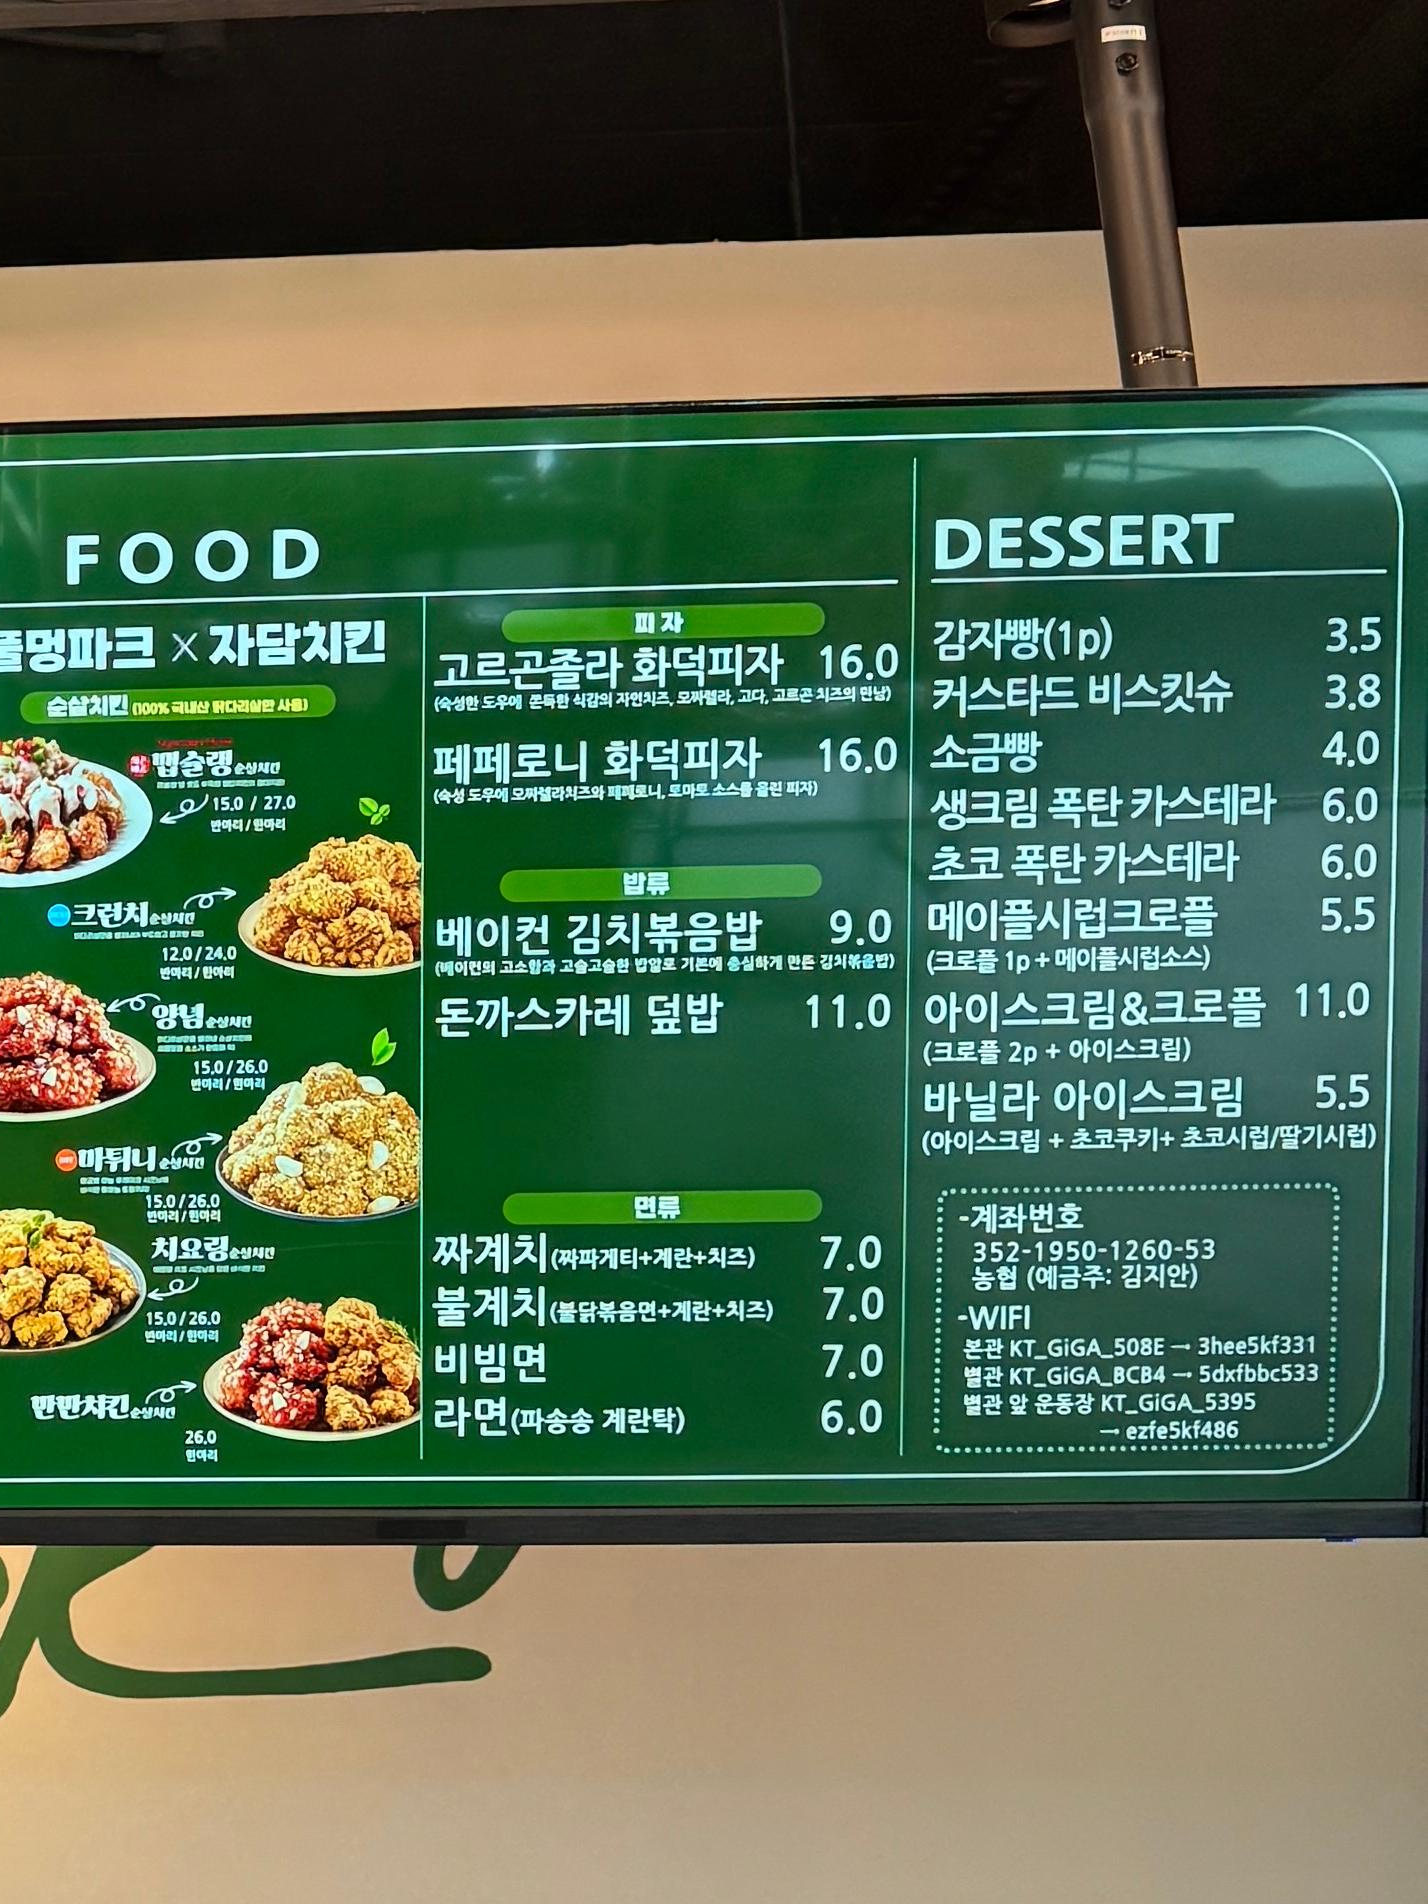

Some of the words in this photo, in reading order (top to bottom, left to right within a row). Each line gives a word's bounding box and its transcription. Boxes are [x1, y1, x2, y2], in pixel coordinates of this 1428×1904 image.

[66, 528, 320, 586] FOOD
[934, 512, 1235, 570] DESSERT
[208, 619, 386, 667] 자담치킨
[933, 616, 1113, 662] 감자빵(1p)
[1325, 616, 1382, 654] 3.5
[433, 646, 624, 691] 고르곤졸라
[631, 642, 785, 689] 화덕피자
[819, 643, 899, 681] 16.0
[932, 674, 1080, 719] 커스타드
[1088, 670, 1234, 716] 비스킷슈
[1324, 673, 1381, 711] 3.8
[213, 796, 244, 812] 15.0
[263, 794, 297, 811] 27.0
[623, 871, 671, 896] 밥류
[436, 914, 550, 958] 베이컨
[566, 910, 764, 955] 김치볶음밥
[829, 908, 892, 946] 9.0
[927, 895, 1219, 942] 메이플시럽크로플
[1321, 896, 1376, 934] 5.5
[924, 1079, 1041, 1124] 바닐라
[1053, 1076, 1243, 1121] 아이스크림
[1315, 1073, 1370, 1111] 5.5
[634, 1195, 681, 1220] 면류
[958, 1202, 1084, 1235] -계좌번호
[957, 1304, 1031, 1331] -WIFI
[434, 1342, 547, 1385] 비빔면
[821, 1343, 884, 1380] 7.0
[1009, 1393, 1029, 1416] 앞
[1034, 1392, 1096, 1416] 운동장
[184, 1429, 217, 1445] 26.0
